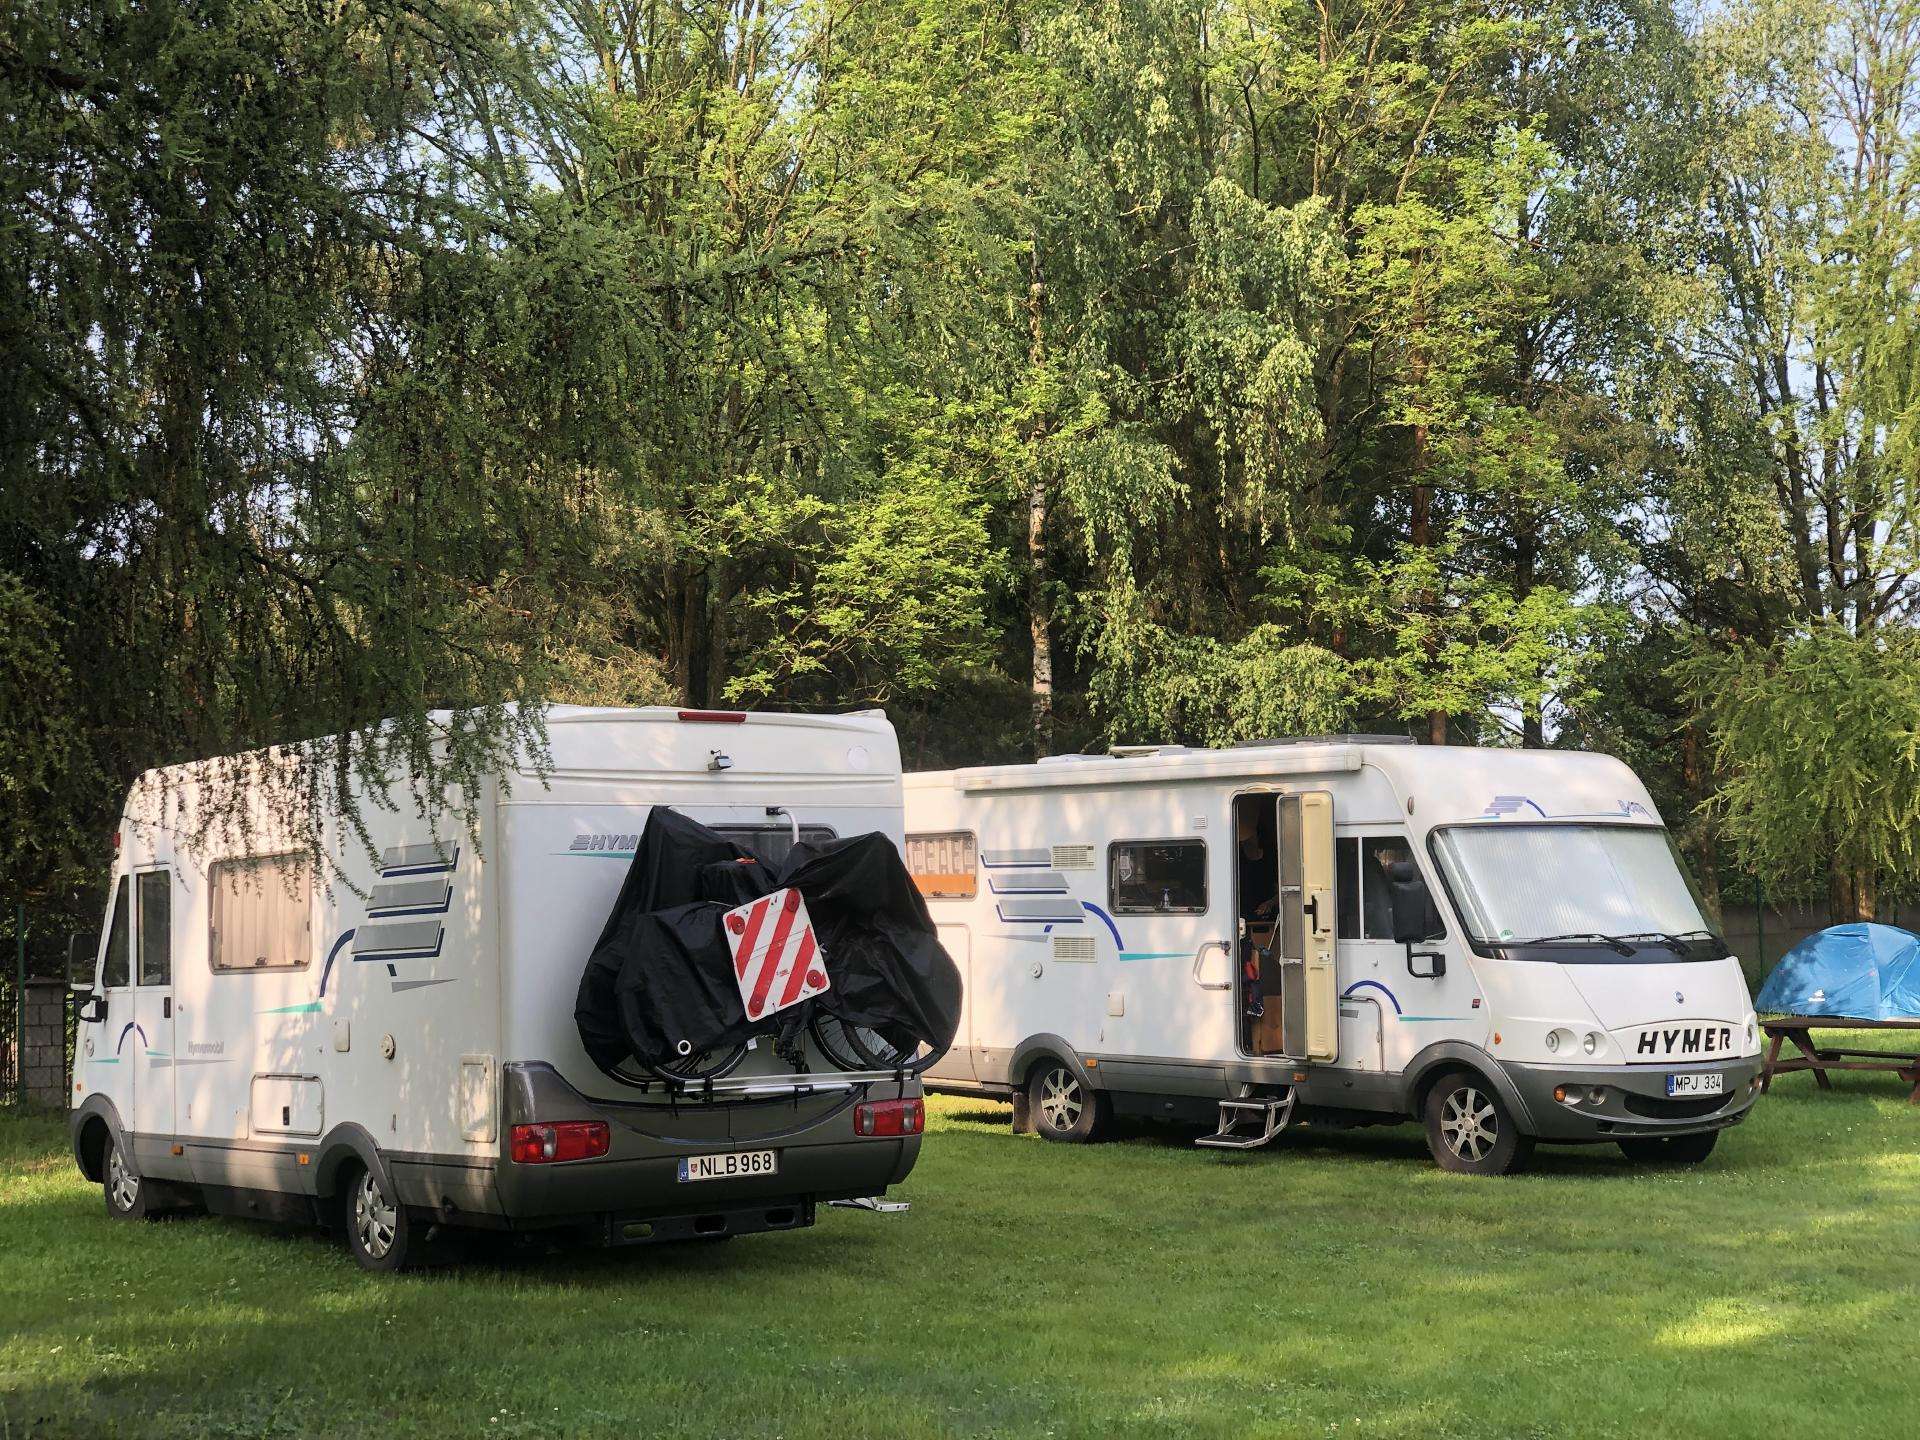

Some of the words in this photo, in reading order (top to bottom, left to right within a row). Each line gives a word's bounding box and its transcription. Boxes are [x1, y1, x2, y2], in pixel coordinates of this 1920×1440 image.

[590, 834, 639, 850] HYM
[1637, 1028, 1731, 1054] HYMER
[1675, 1076, 1699, 1092] MPJ
[1704, 1075, 1721, 1090] 334
[700, 1152, 772, 1177] NLB968
